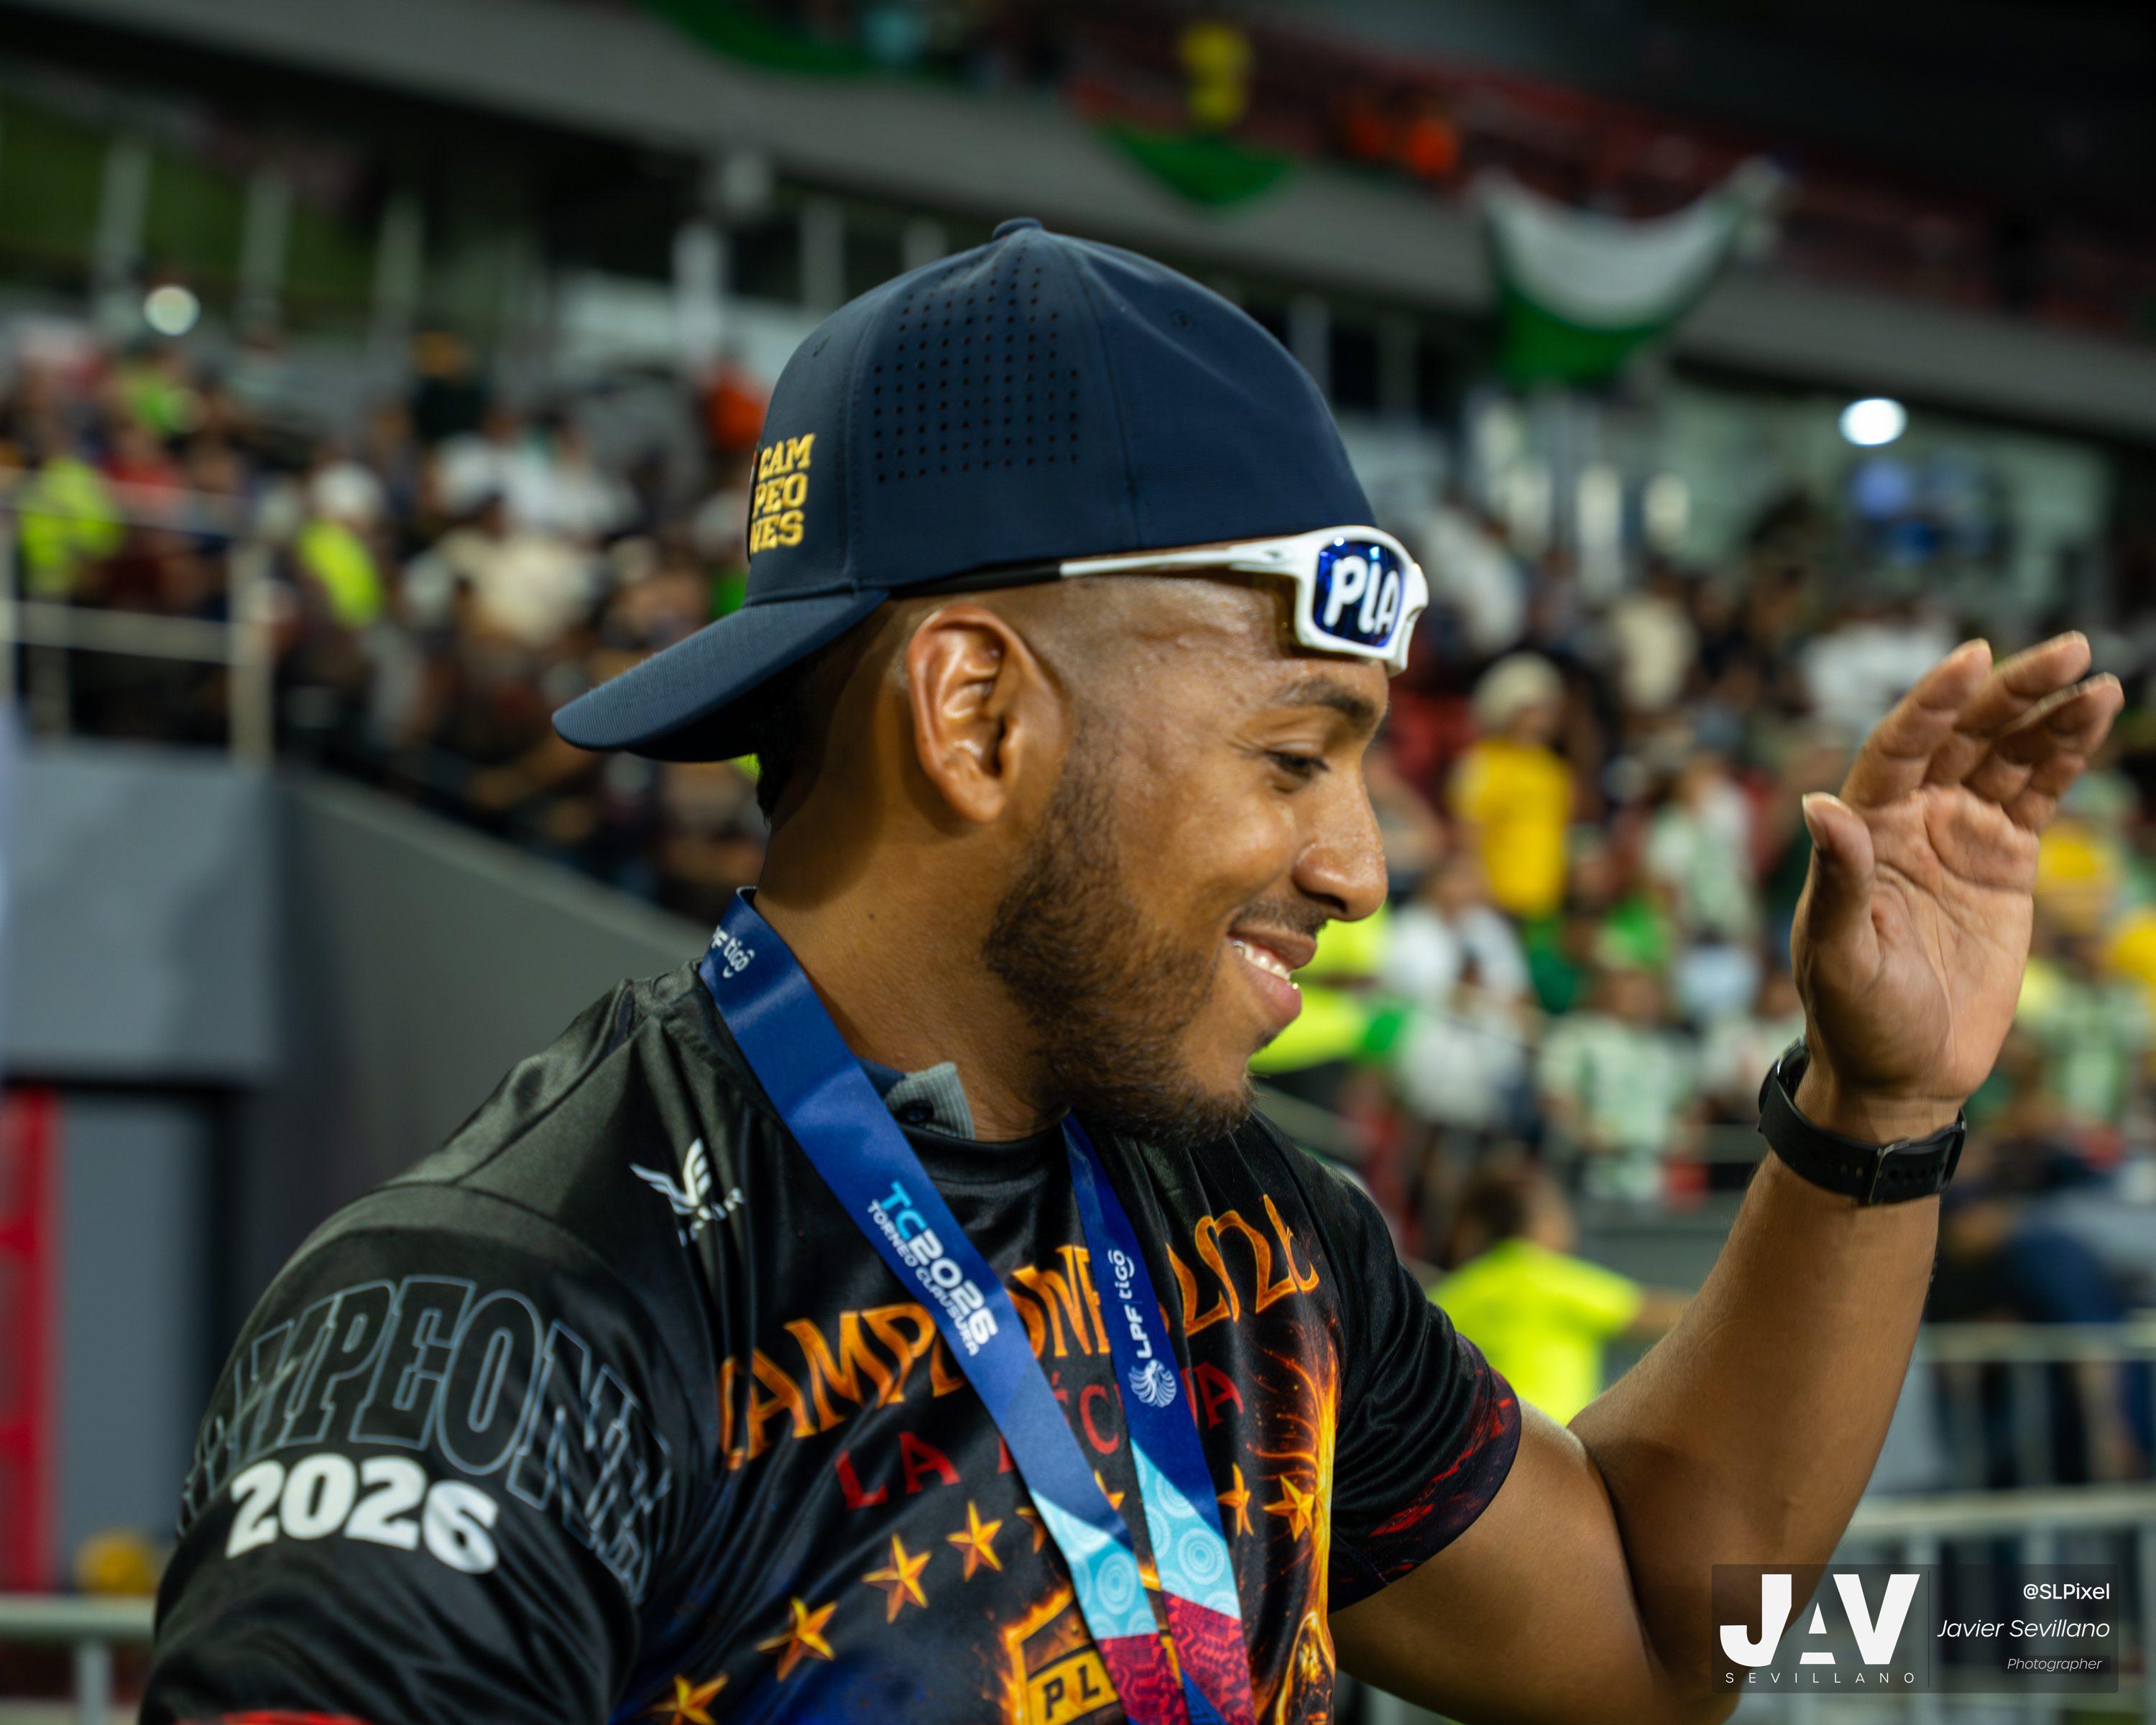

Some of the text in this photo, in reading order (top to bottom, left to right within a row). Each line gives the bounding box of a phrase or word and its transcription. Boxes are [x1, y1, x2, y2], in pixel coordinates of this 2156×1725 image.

[752, 472, 808, 520] PEO
[757, 433, 815, 482] CAM
[867, 1198, 980, 1357] TORNEO CLAUSURA
[880, 1180, 999, 1346] TC2026
[1124, 1304, 1153, 1358] LPF
[834, 1431, 961, 1510] LA
[226, 1453, 499, 1573] 2026
